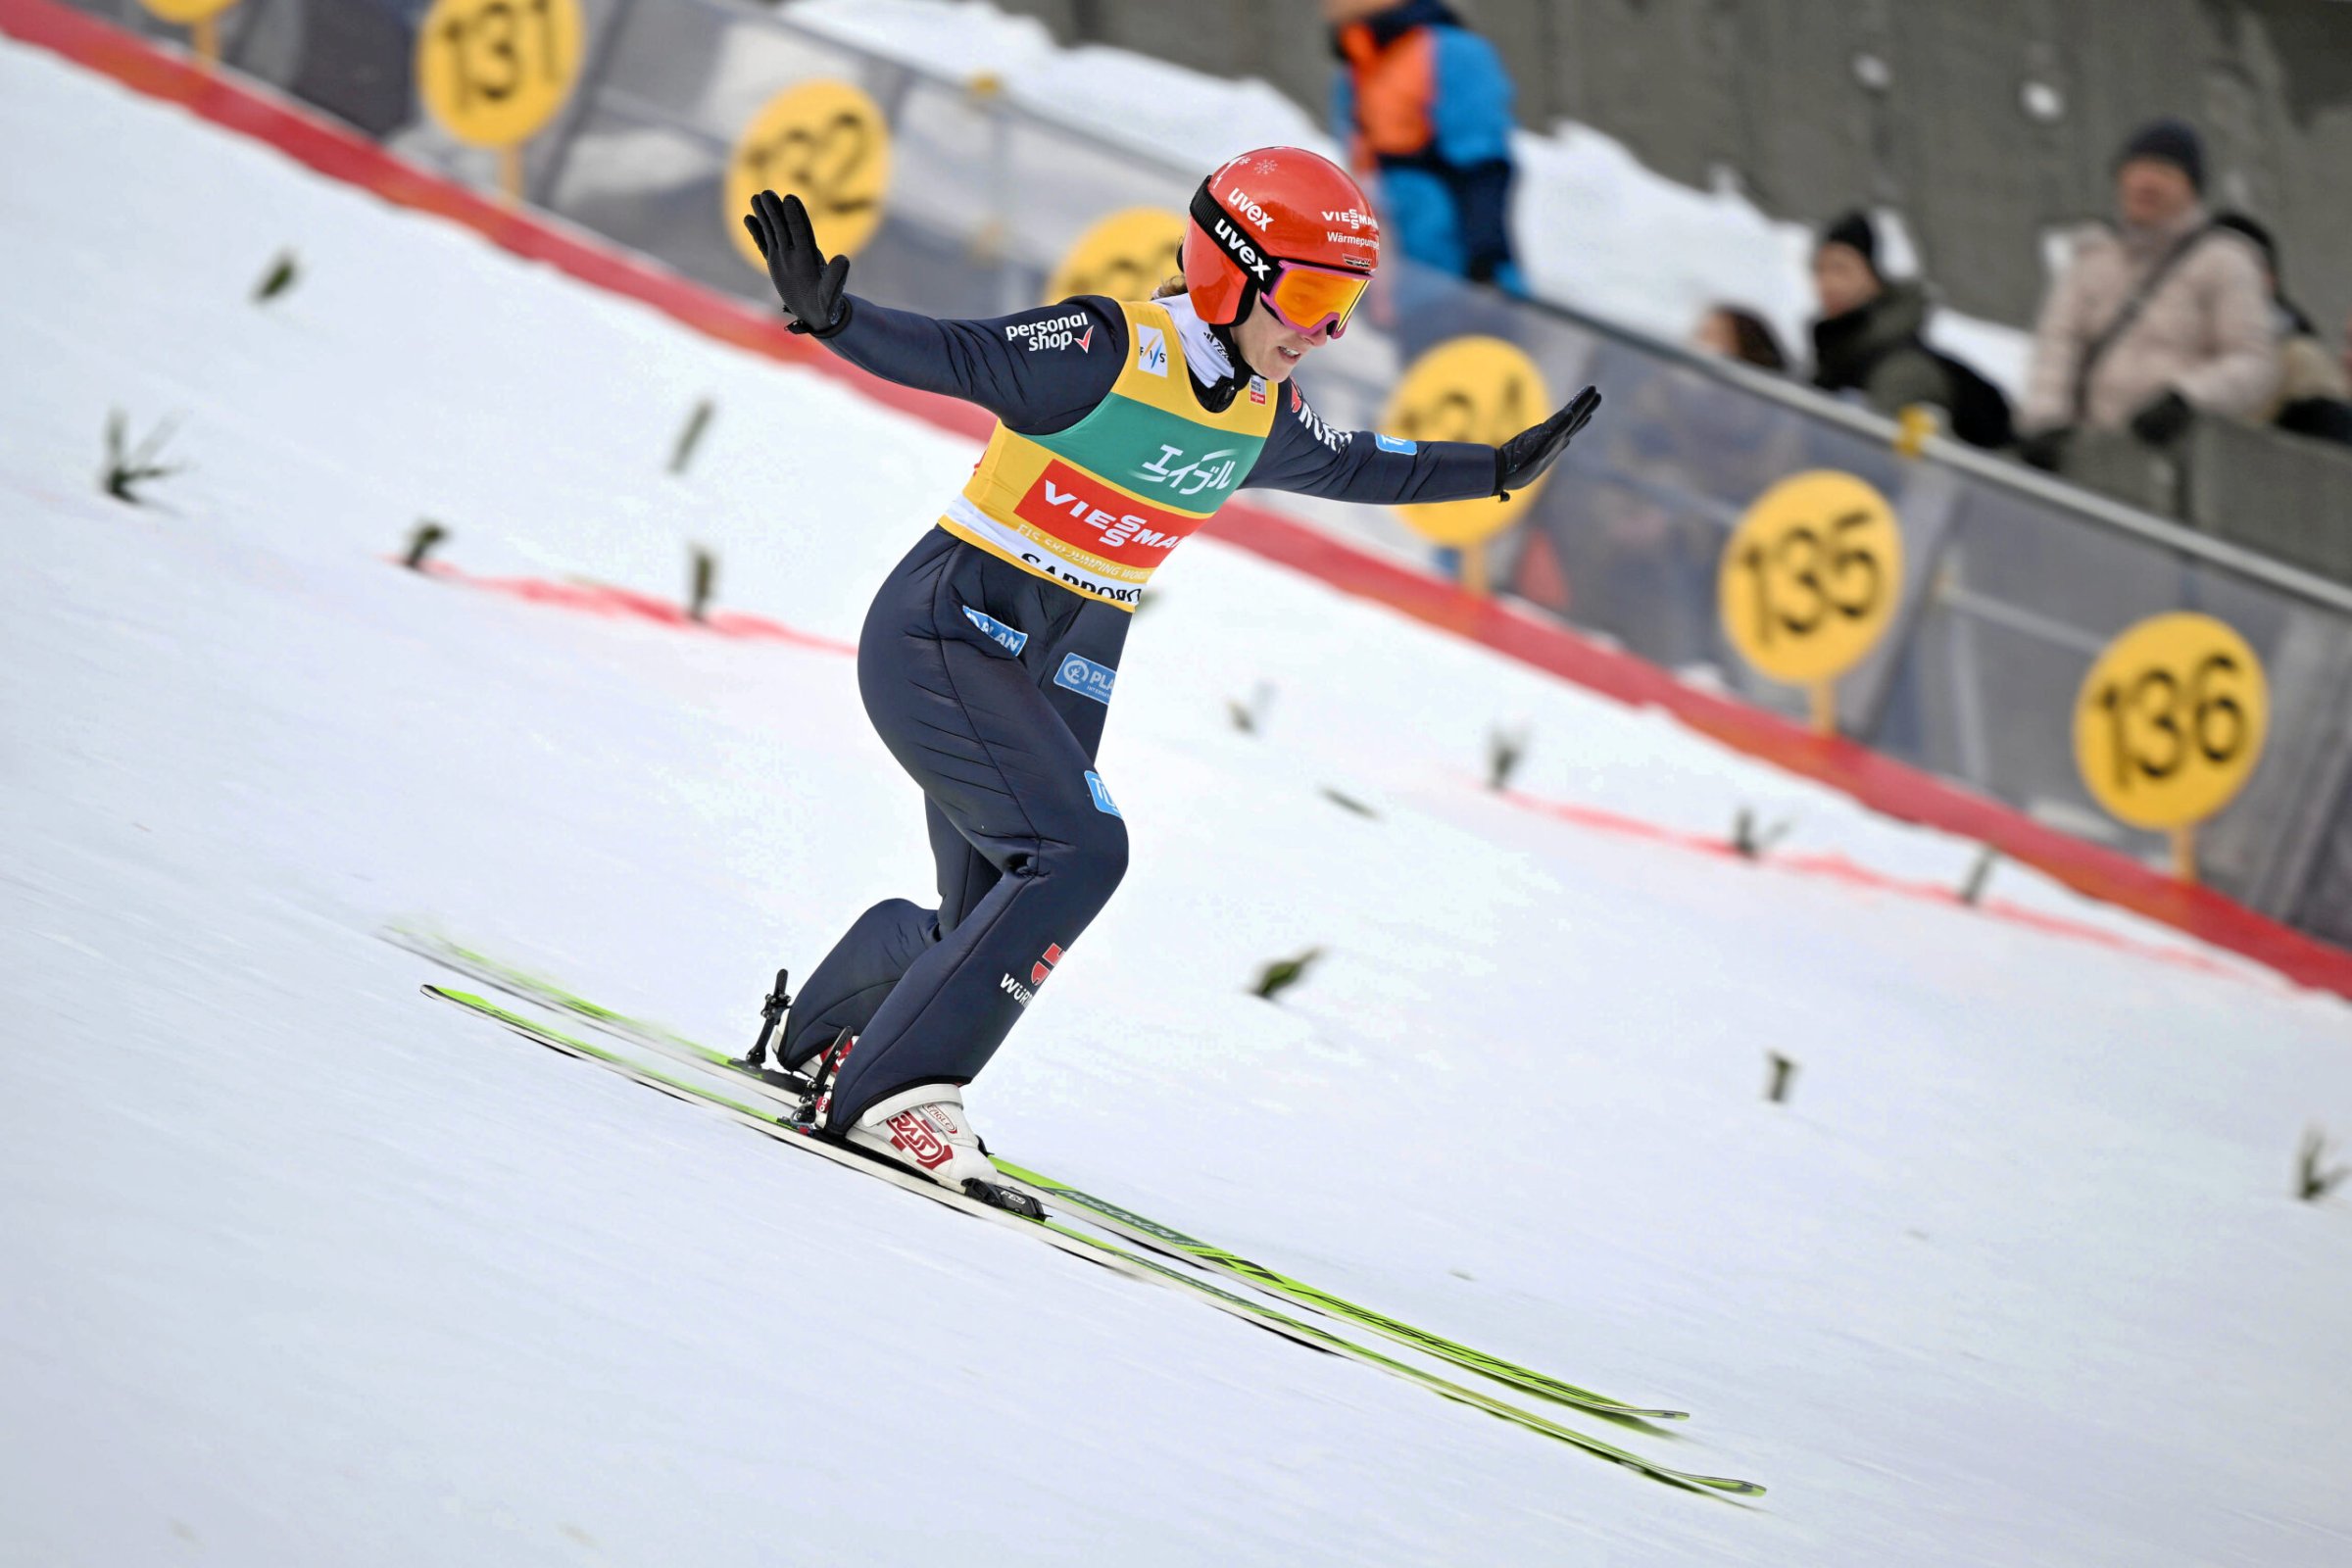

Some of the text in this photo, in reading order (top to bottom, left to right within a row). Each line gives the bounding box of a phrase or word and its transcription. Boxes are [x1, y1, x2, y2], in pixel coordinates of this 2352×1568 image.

[441, 0, 562, 113] 131
[1227, 187, 1274, 232] uvex
[1214, 218, 1272, 281] uvex
[1005, 312, 1089, 341] personal
[1028, 330, 1074, 352] shop
[1139, 346, 1167, 364] FIS
[1135, 444, 1237, 495] エイブル
[1045, 480, 1182, 549] VIESSMA
[1743, 510, 1884, 649] 135
[2096, 651, 2247, 794] 136
